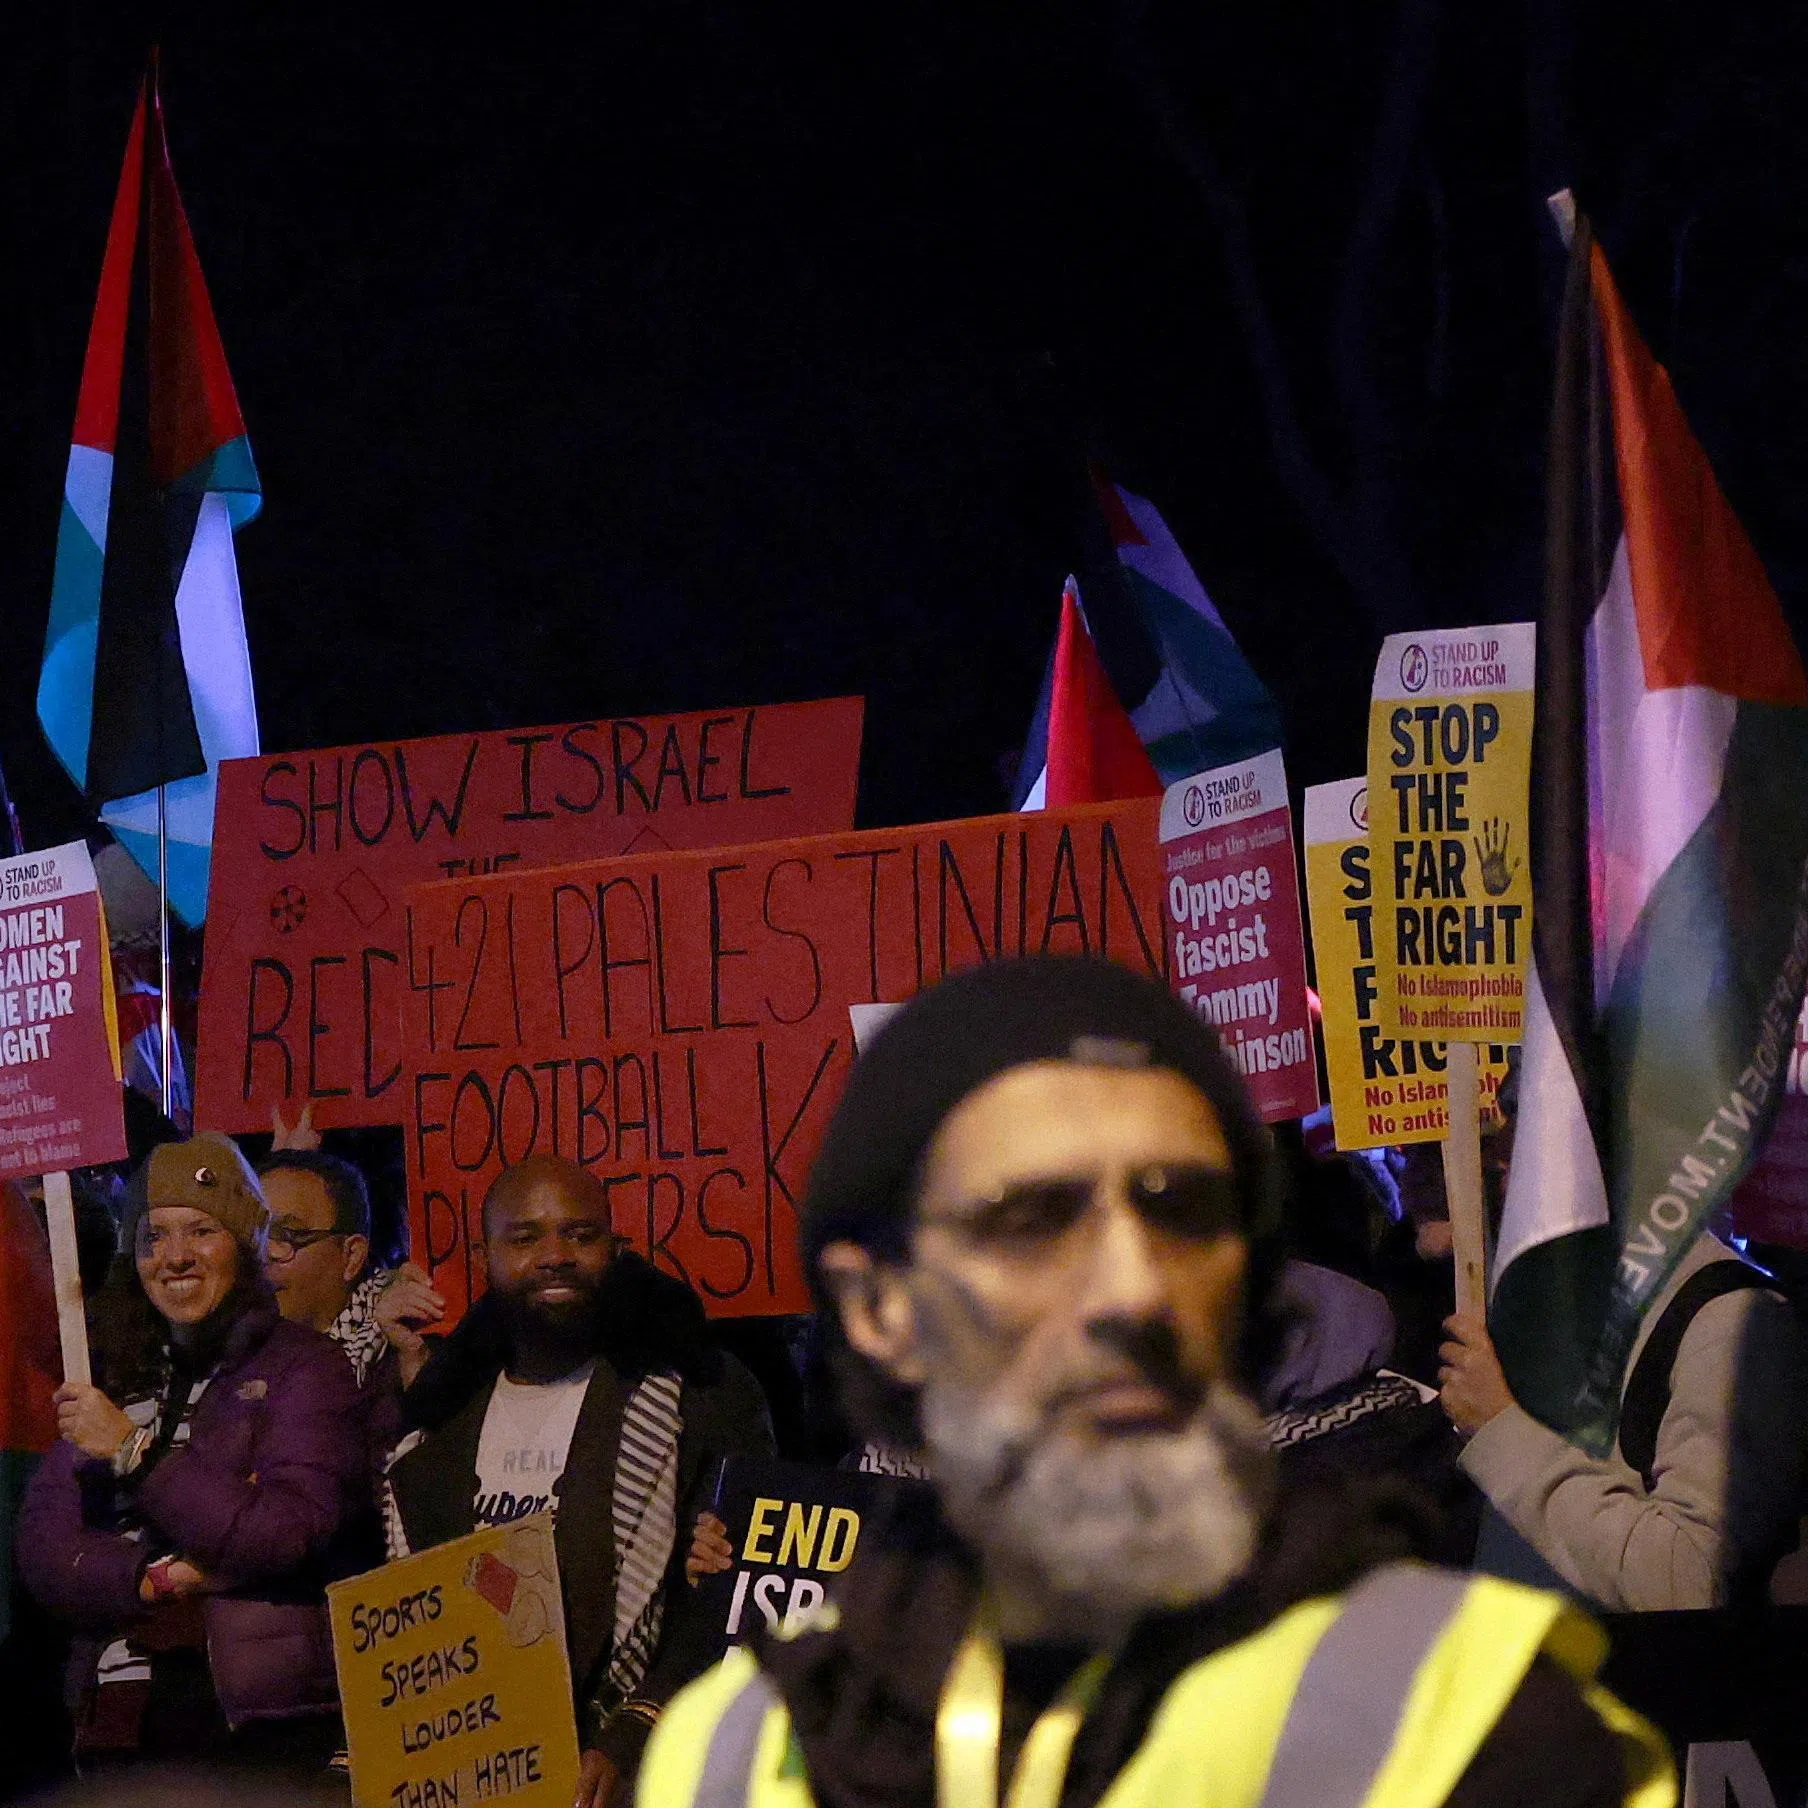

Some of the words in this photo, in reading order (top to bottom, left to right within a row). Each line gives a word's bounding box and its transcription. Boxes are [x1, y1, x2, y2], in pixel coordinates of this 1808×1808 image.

[1433, 642, 1477, 665] STAND
[1480, 641, 1499, 661] UP
[1433, 669, 1450, 688] TO
[1452, 664, 1506, 687] RACISM
[1391, 703, 1499, 767] STOP
[259, 739, 478, 859] SHOW
[504, 709, 791, 821] ISRAEL
[1206, 776, 1239, 800] STAND
[1242, 770, 1255, 789] UP
[1208, 801, 1222, 819] TO
[1225, 790, 1261, 814] RACISM
[1391, 772, 1469, 833] THE
[5, 864, 39, 885] STAND
[41, 860, 56, 876] UP
[6, 886, 20, 901] TO
[23, 876, 62, 898] RACISM
[1168, 866, 1271, 930] Oppose
[1394, 840, 1466, 900] FAR
[406, 893, 521, 1053] 421
[551, 820, 1168, 1039] PALESTINIAN
[1175, 914, 1270, 979] fascist
[1396, 905, 1522, 966] RIGHT
[26, 981, 74, 1019] FAR
[1397, 974, 1416, 996] No
[1420, 972, 1522, 1001] Islamophobia
[1399, 1005, 1417, 1027] No
[415, 1048, 727, 1179] FOOTBALL
[1365, 1086, 1393, 1108] No
[1368, 1114, 1395, 1135] No
[741, 1497, 860, 1573] END
[351, 1585, 443, 1654] SPORTS
[380, 1636, 479, 1707] SPEAKS
[400, 1693, 503, 1754] LOUDER
[475, 1745, 542, 1801] HATE
